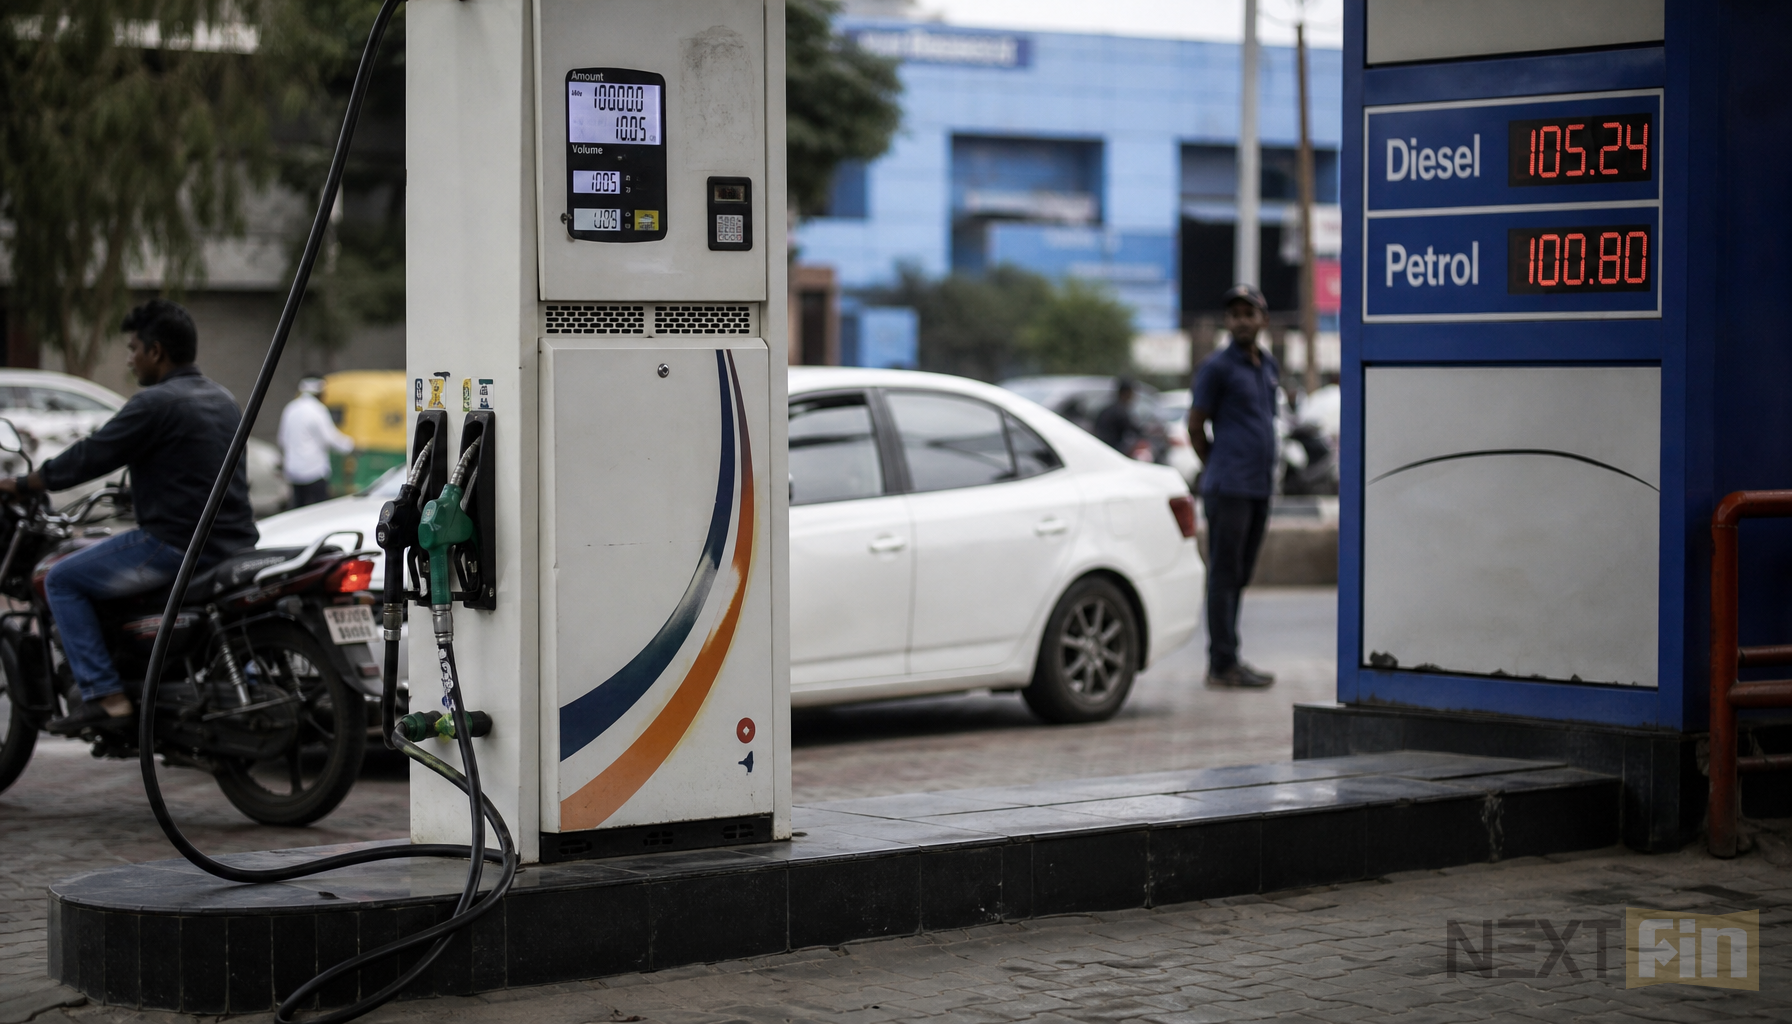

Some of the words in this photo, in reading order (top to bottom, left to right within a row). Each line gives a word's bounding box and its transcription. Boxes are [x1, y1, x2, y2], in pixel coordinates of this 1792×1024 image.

[571, 71, 604, 81] Amount
[616, 116, 646, 141] 10.05
[572, 145, 603, 155] Volume
[1387, 134, 1480, 181] Diesel
[1529, 122, 1649, 178] 105.24
[1386, 241, 1479, 287] Petrol
[1528, 231, 1648, 286] 100.80
